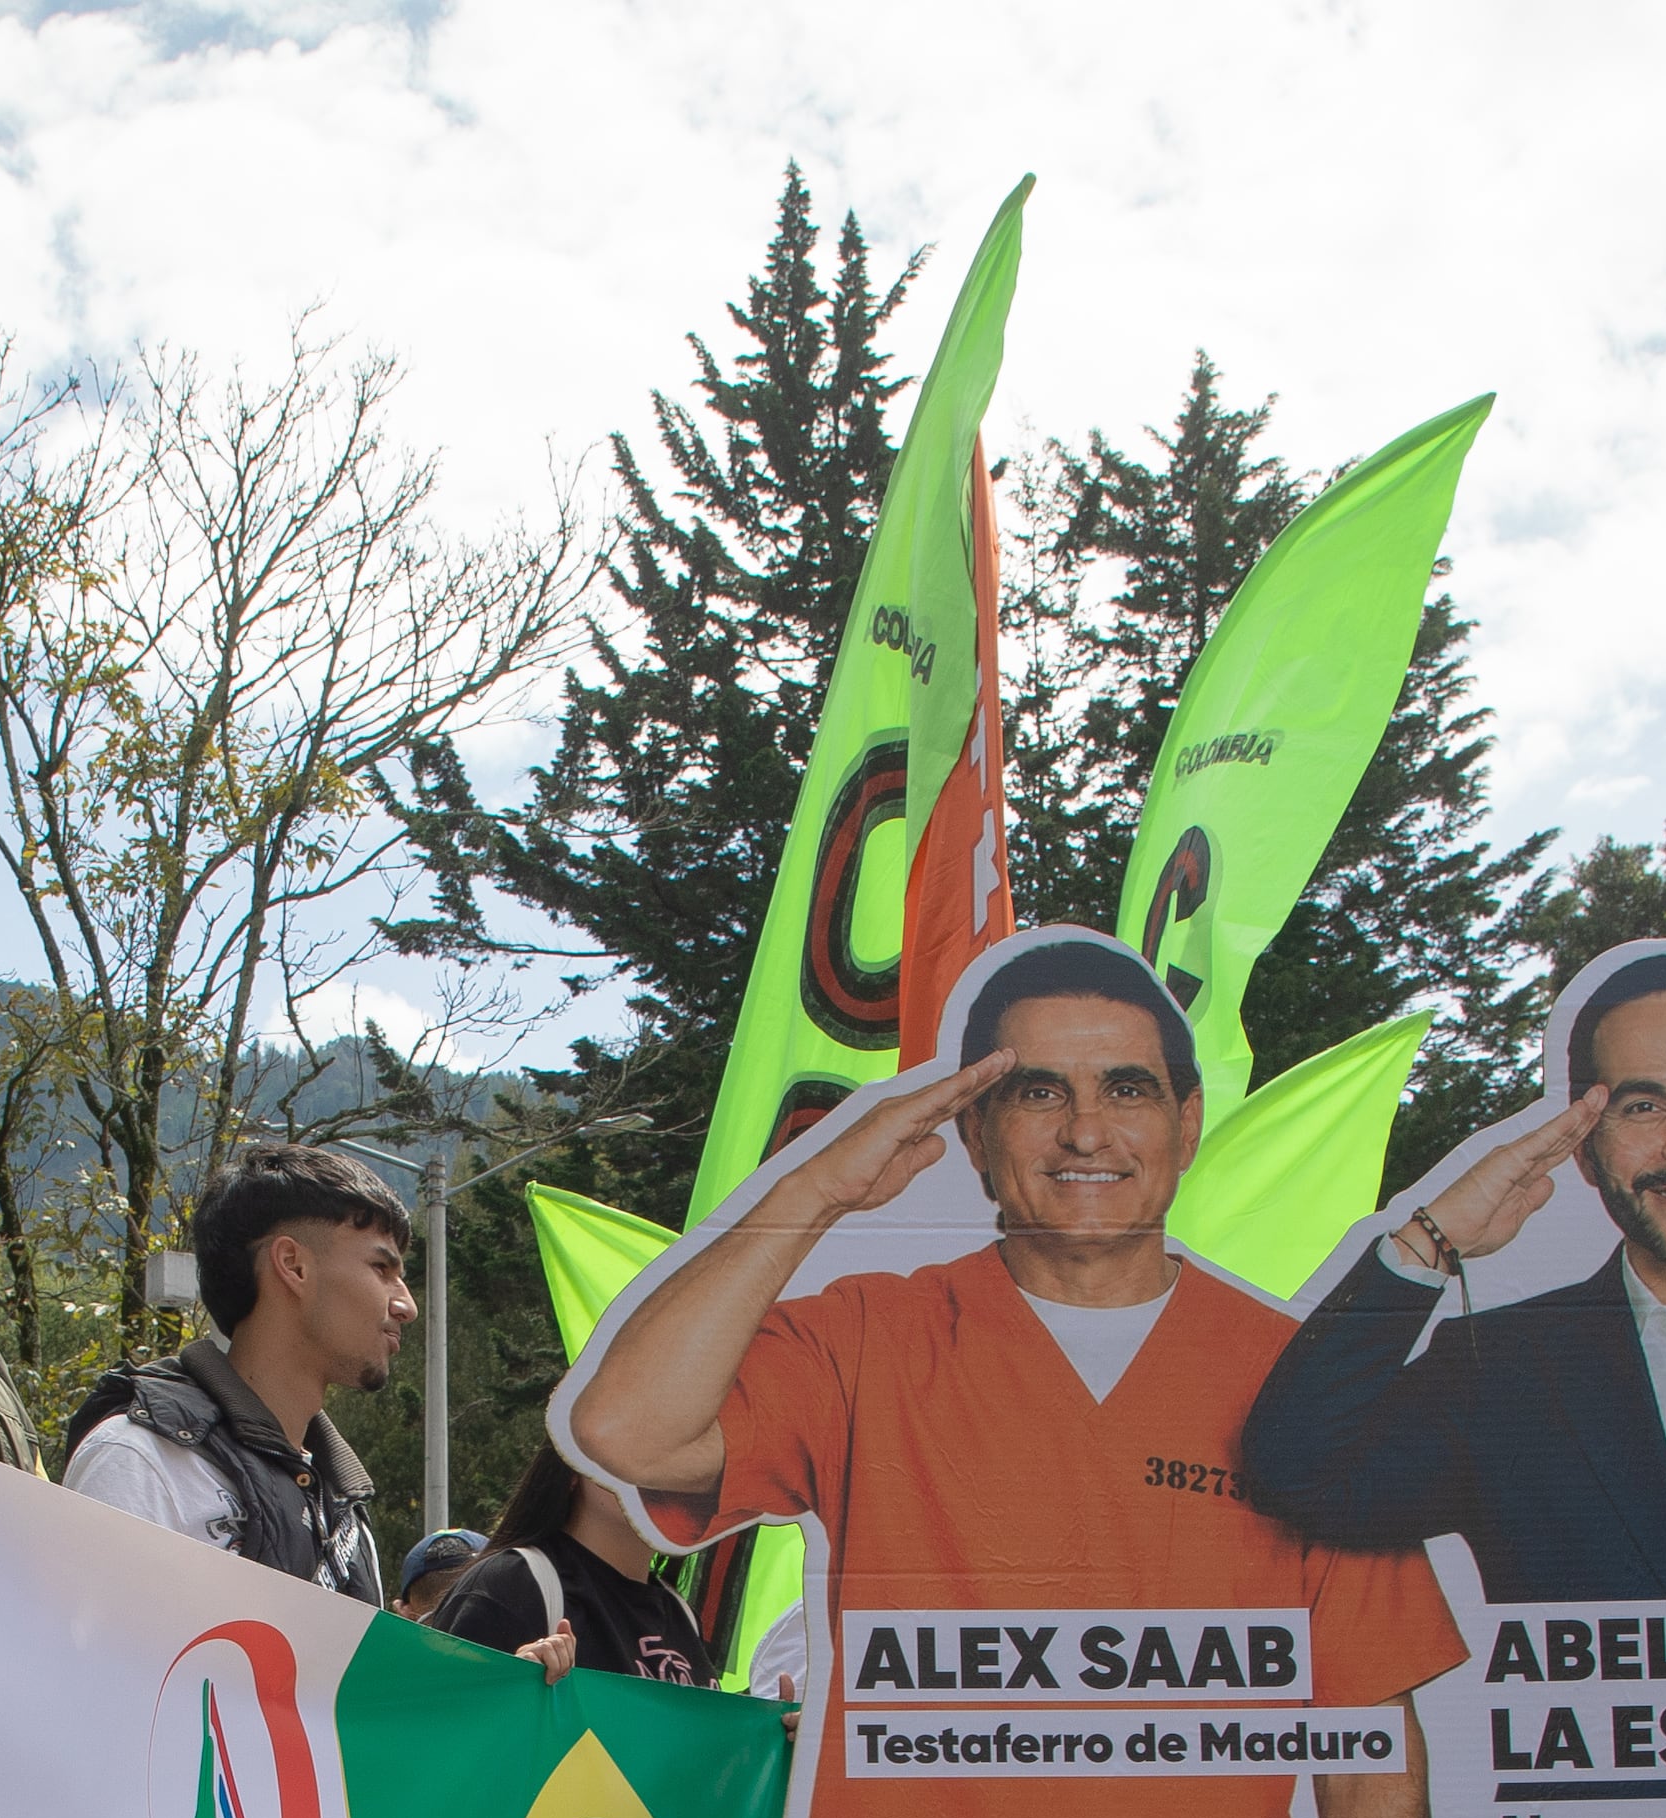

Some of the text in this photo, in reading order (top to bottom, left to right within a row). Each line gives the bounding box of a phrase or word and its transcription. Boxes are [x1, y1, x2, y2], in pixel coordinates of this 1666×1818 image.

[1175, 733, 1274, 779] COLOMBIA
[855, 1625, 1298, 1690] ALEX SAAB
[857, 1721, 1393, 1765] Testaferro de Maduro
[1490, 1706, 1594, 1771] LA
